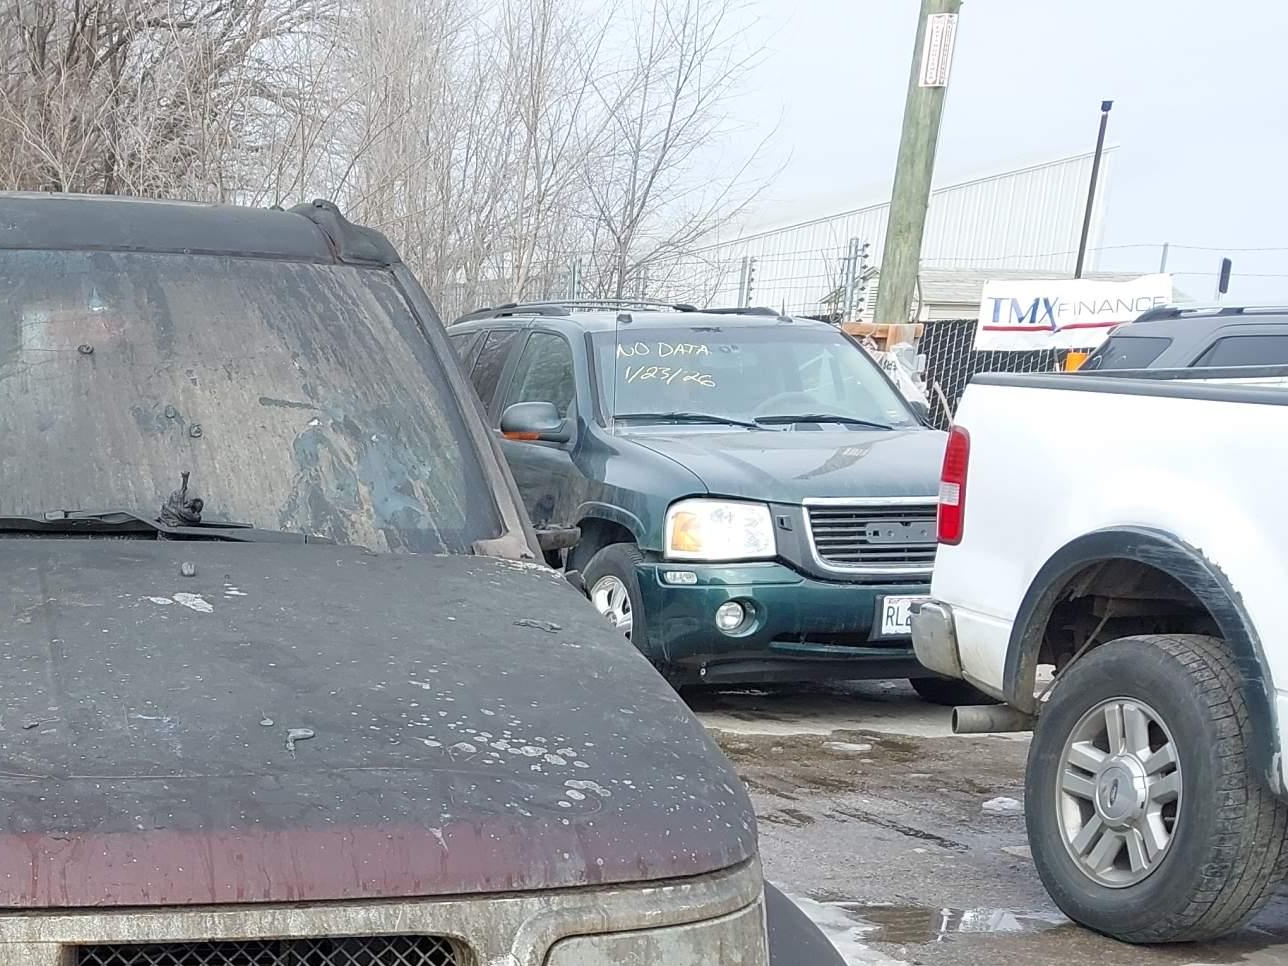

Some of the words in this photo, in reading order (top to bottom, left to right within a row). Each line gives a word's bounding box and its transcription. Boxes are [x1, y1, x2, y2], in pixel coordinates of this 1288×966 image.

[988, 296, 1059, 334] TMX
[616, 342, 650, 358] NO
[657, 342, 710, 358] DATA
[625, 366, 716, 387] 1/23/26
